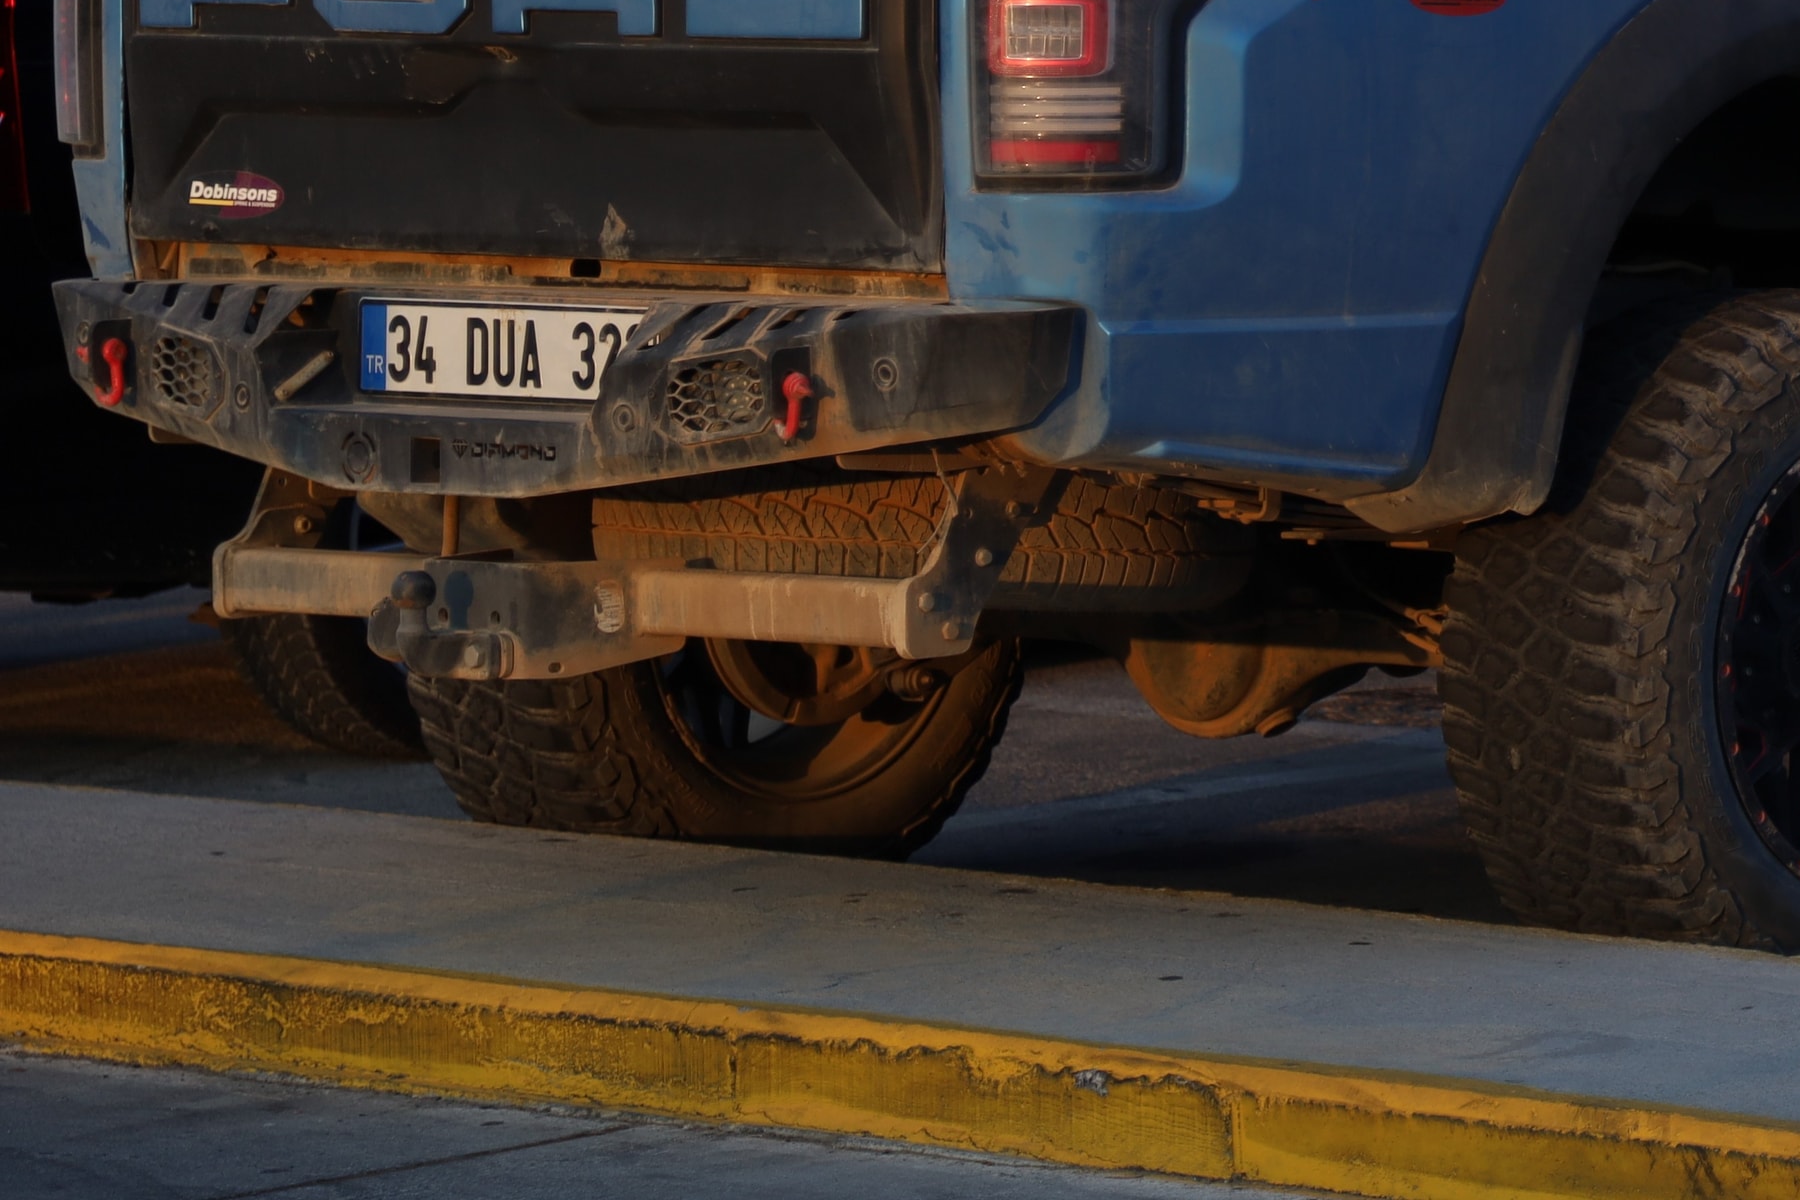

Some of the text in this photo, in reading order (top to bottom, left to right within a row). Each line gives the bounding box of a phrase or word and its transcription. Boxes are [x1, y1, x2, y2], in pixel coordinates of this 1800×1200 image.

[189, 179, 278, 203] Dobinsons
[366, 314, 640, 391] TR 34 DUA 32
[470, 442, 557, 462] DIAMOND
